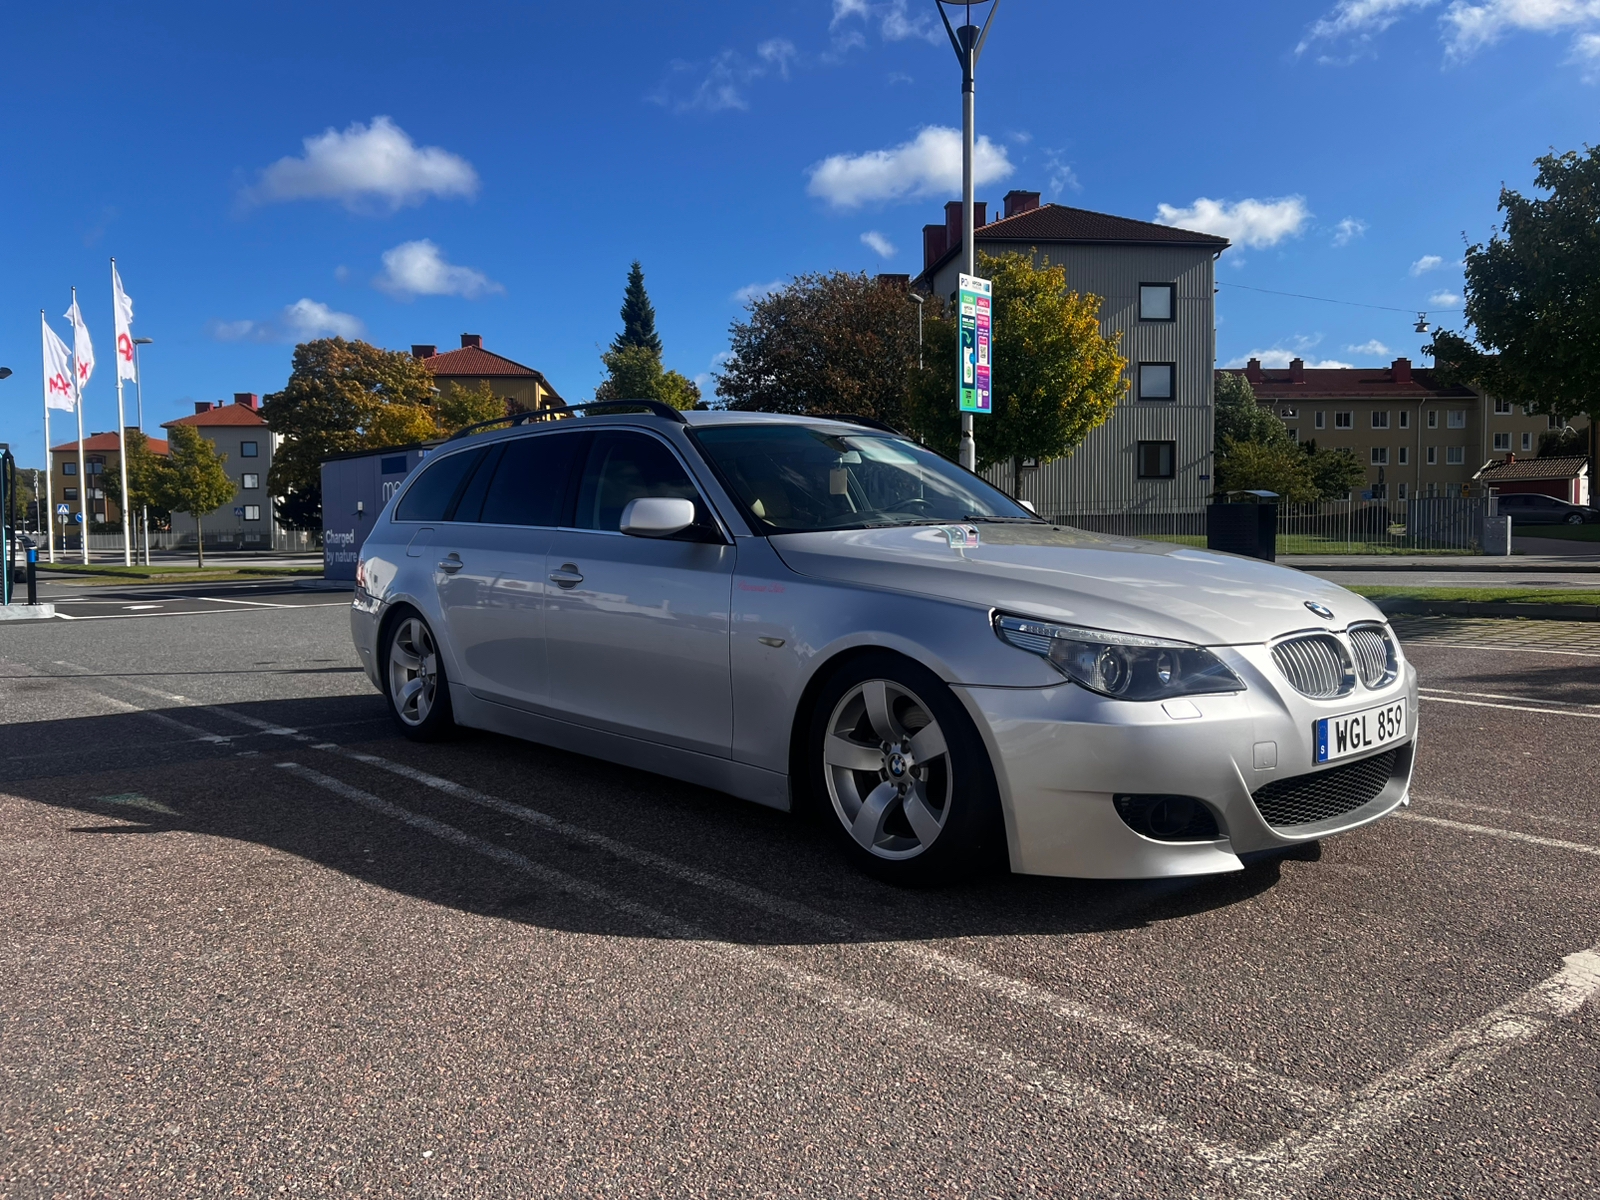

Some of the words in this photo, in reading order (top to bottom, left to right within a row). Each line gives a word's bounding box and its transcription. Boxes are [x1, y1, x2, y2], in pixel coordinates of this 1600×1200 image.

[326, 529, 354, 547] Charged
[326, 548, 334, 566] by
[335, 549, 357, 562] nature
[1336, 715, 1372, 753] WGL
[1378, 704, 1402, 741] 859
[1320, 745, 1325, 754] S
